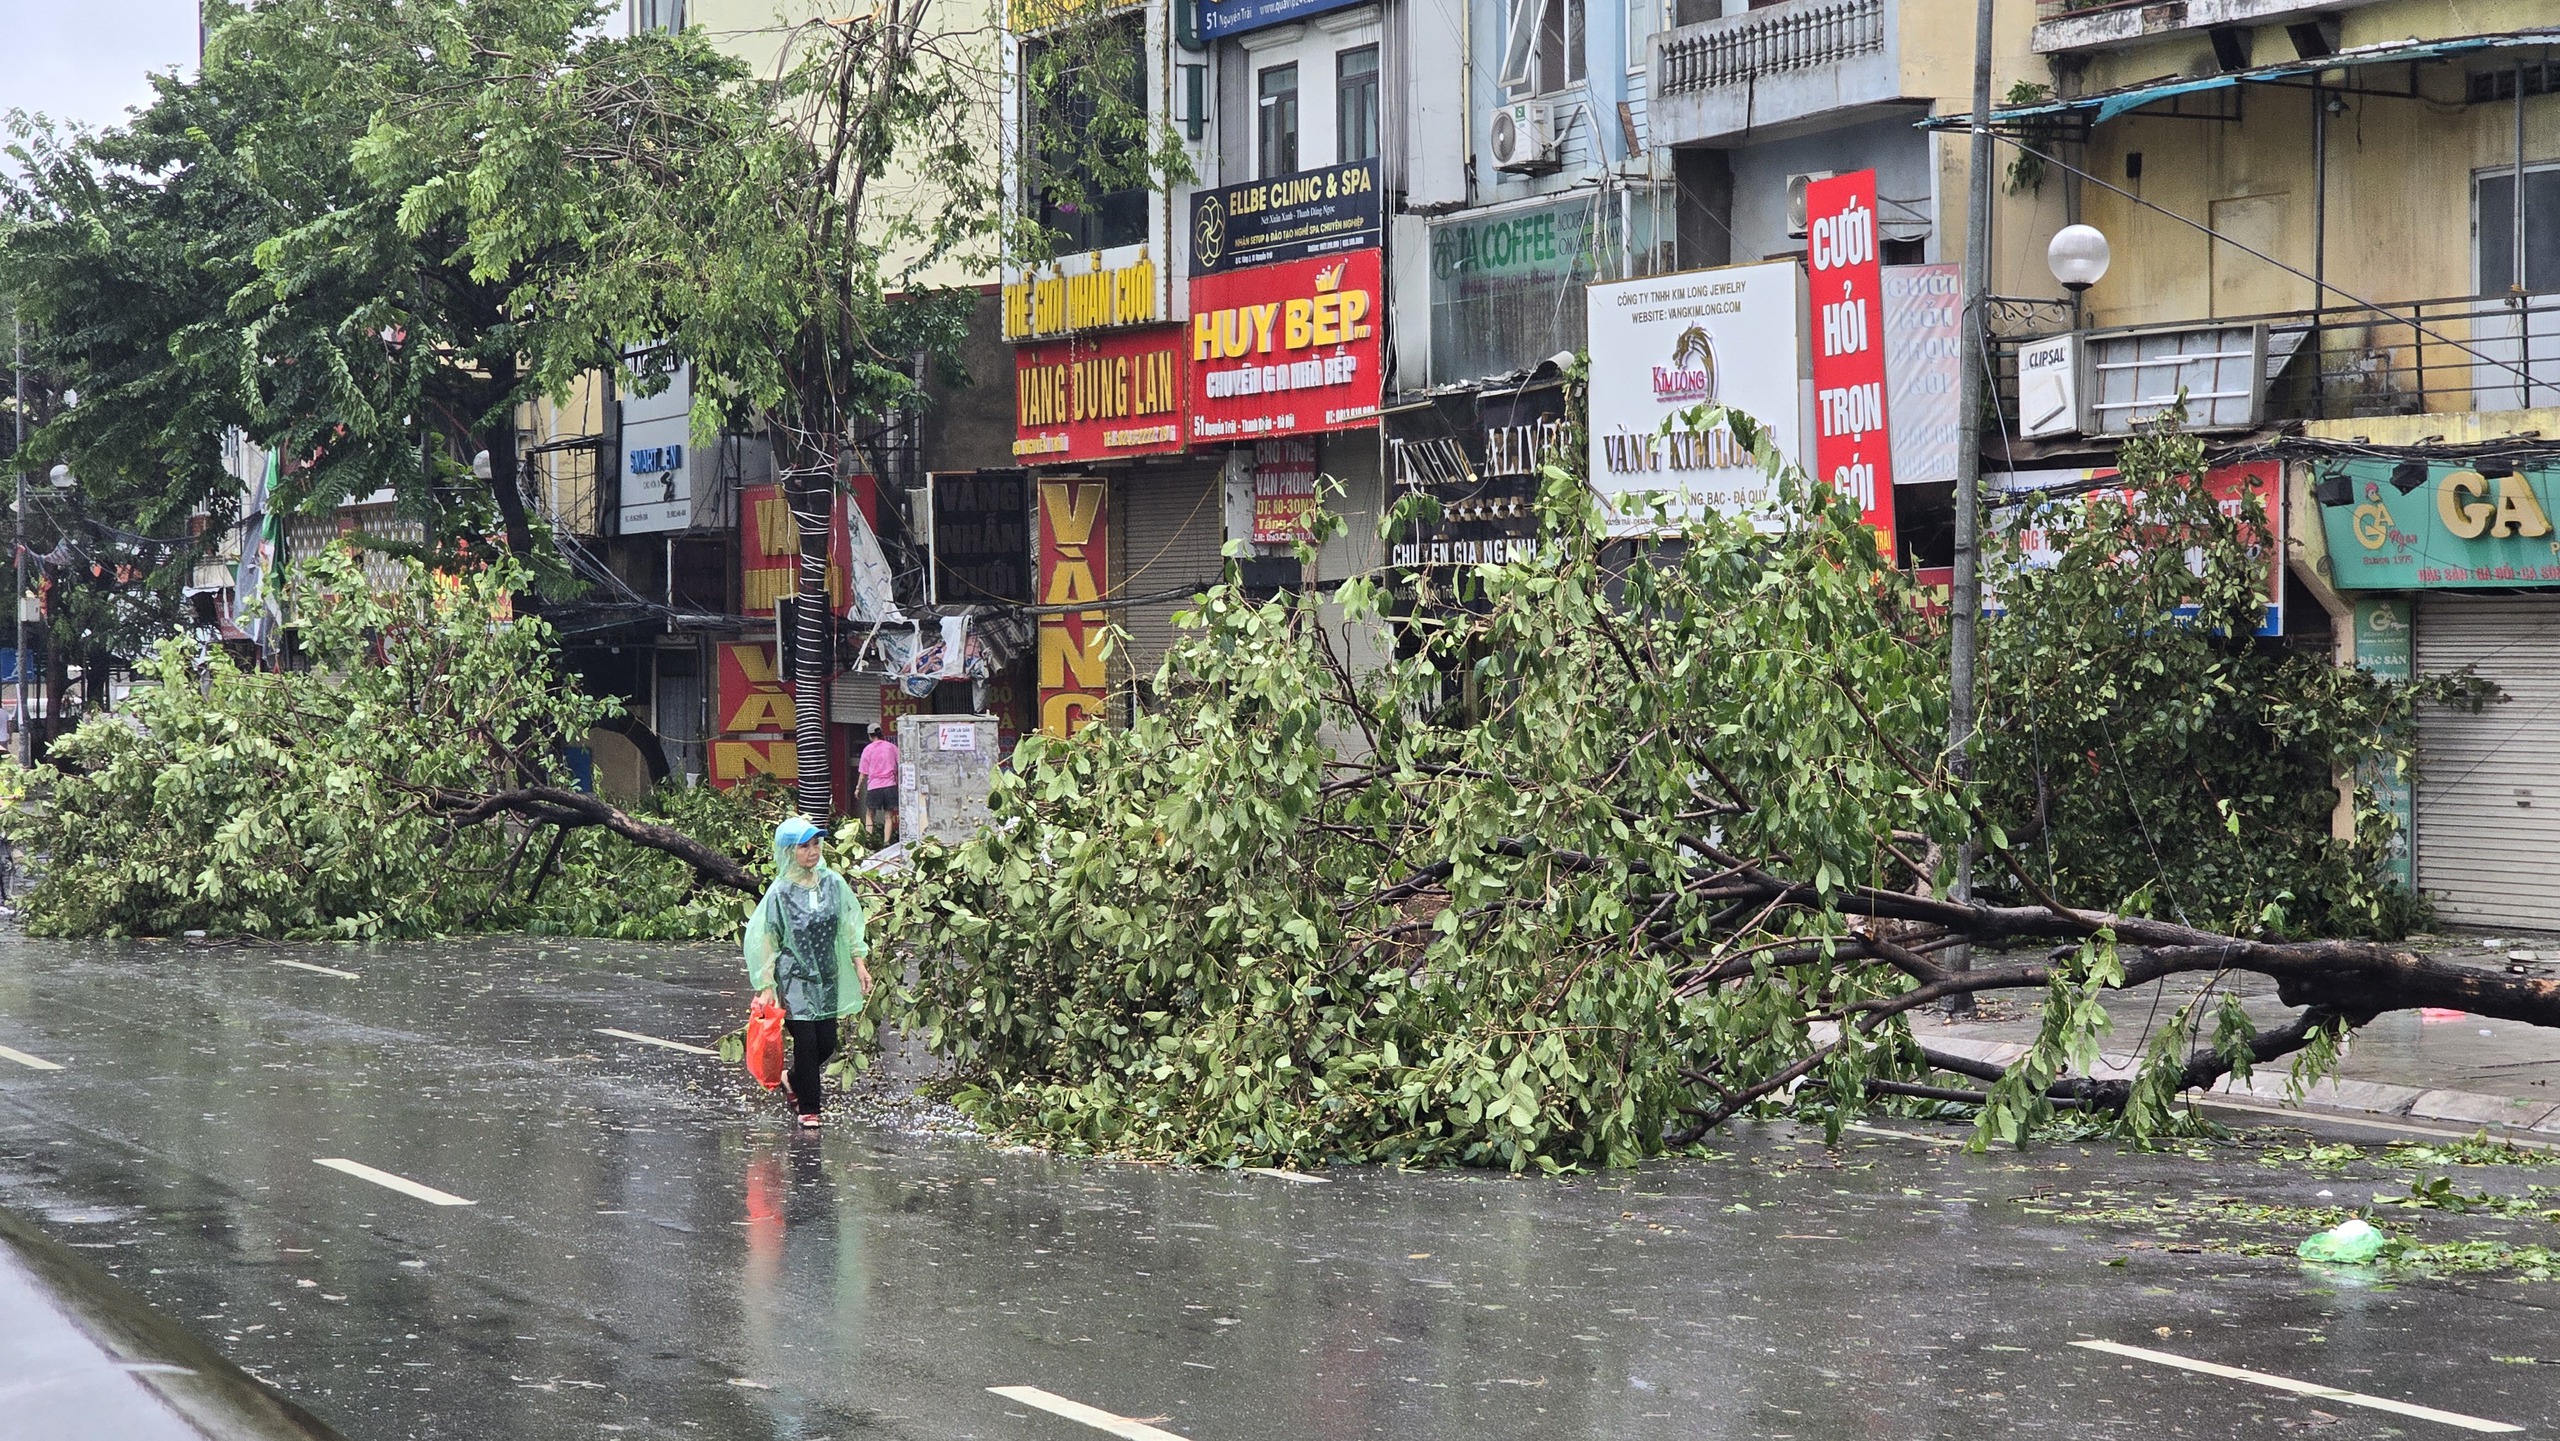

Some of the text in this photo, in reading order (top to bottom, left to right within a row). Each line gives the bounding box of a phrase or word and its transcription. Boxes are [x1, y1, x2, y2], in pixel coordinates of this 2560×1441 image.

[1206, 11, 1218, 31] 51
[1229, 166, 1372, 216] ELLBE CLINIC & SPA
[1309, 225, 1320, 235] SPA
[1320, 220, 1343, 232] CHUYÊN
[1481, 211, 1556, 269] COFFEE
[1812, 194, 1874, 271] CƯỚI
[1617, 280, 1747, 307] CÔNG TY TNHH KIM LONG JEWELRY
[1193, 301, 1281, 361] HUY
[1822, 279, 1869, 357] HỎI
[1323, 345, 1358, 386] BẾP
[2029, 347, 2065, 368] CLIPSAL
[1019, 352, 1069, 427] VÀNG
[1134, 351, 1174, 416] LAN
[1194, 415, 1206, 436] 51
[1819, 382, 1883, 444] TRỌN
[1256, 435, 1315, 464] CHO THUÊ
[1603, 423, 1663, 474] VÀNG
[940, 477, 1020, 512] VÀNG
[1256, 466, 1315, 496] VĂN PHÒNG
[1707, 492, 1726, 508] BẠC
[1733, 487, 1747, 504] ĐÁ
[1834, 452, 1876, 512] GÓI
[1256, 500, 1271, 515] DT:
[1392, 534, 1450, 567] CHUÊN
[1453, 539, 1478, 565] GIA
[2363, 556, 2390, 565] Since
[2384, 652, 2407, 665] SẢN
